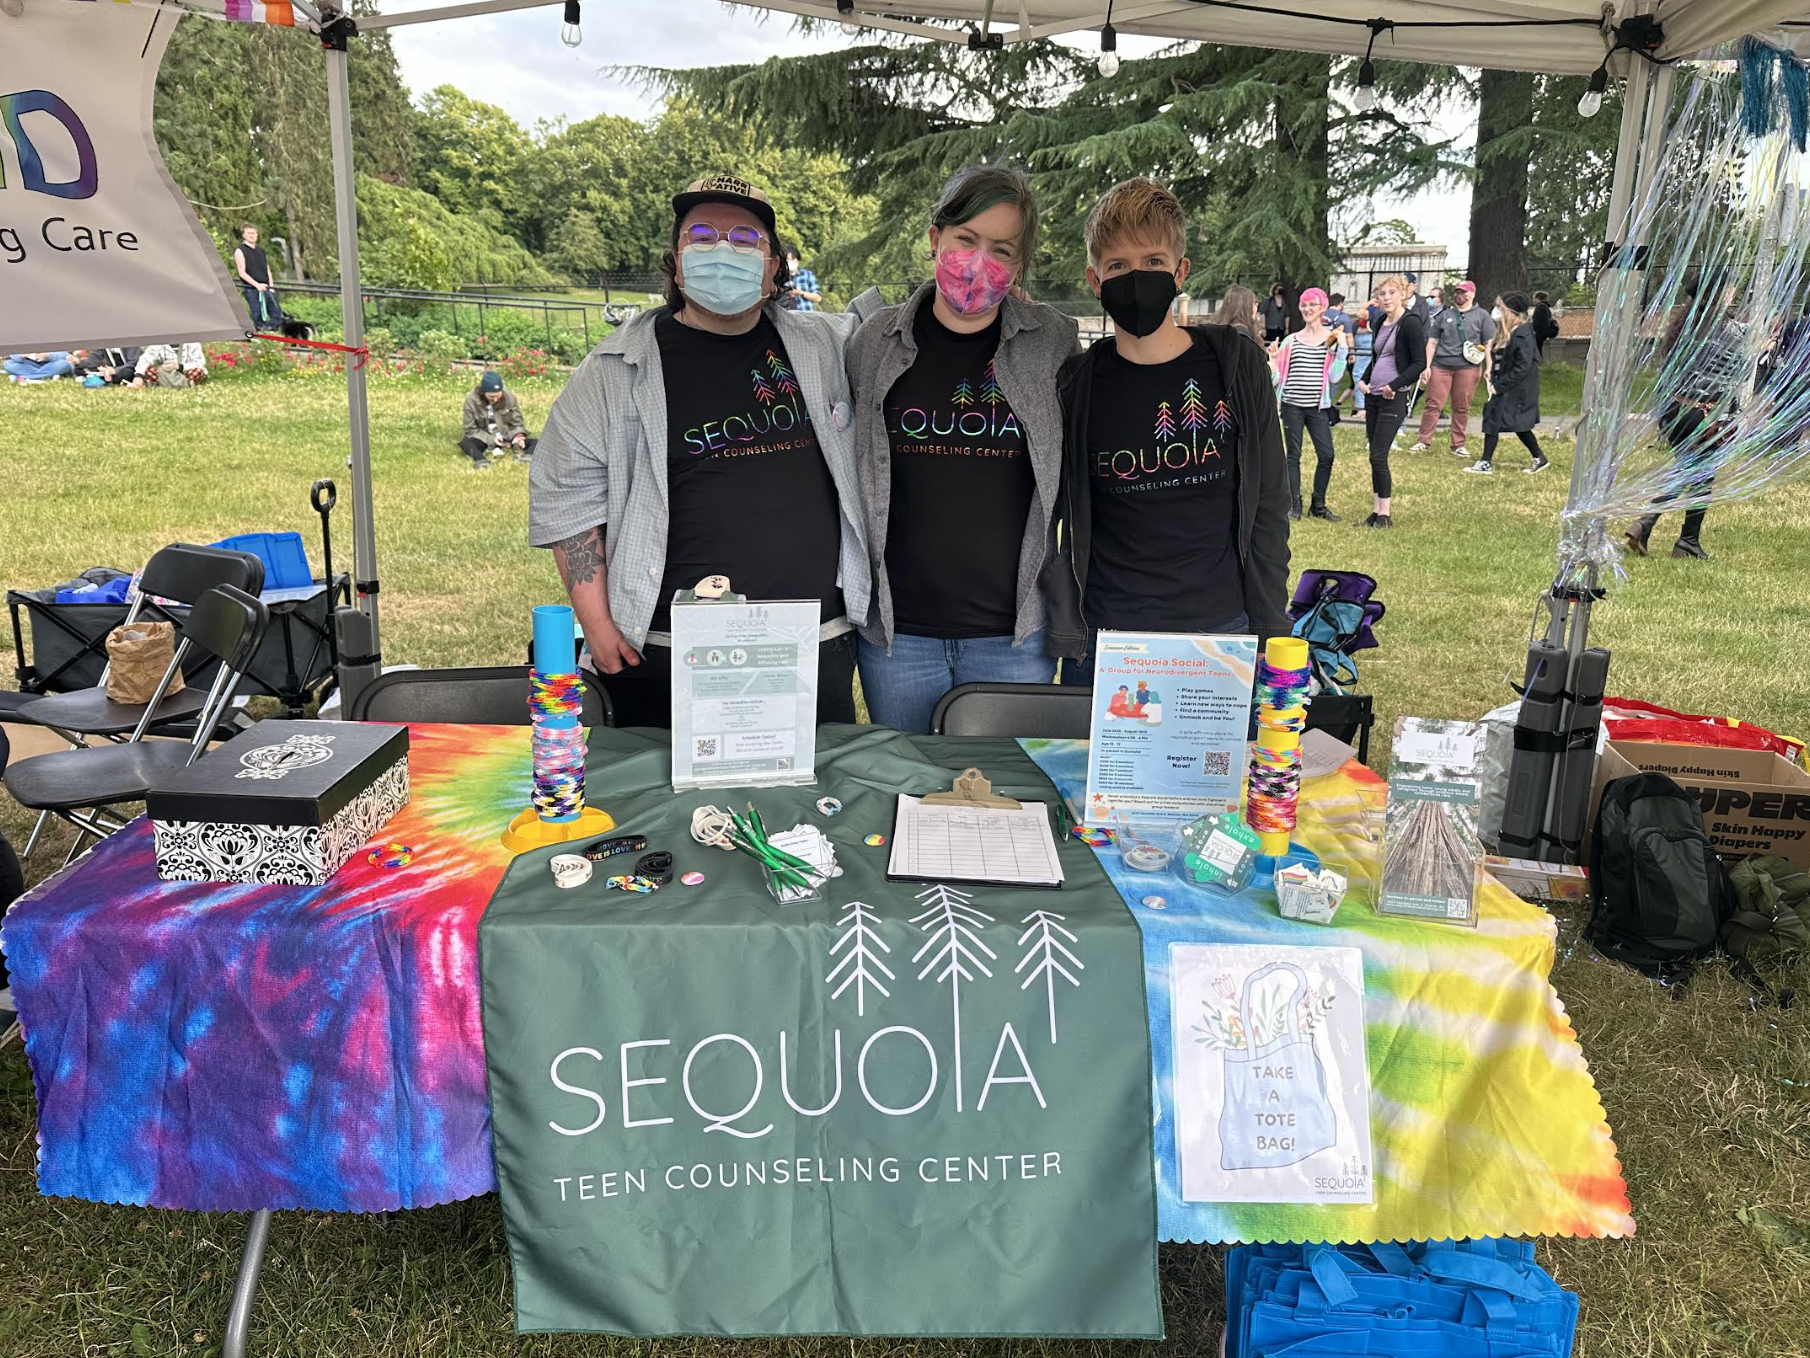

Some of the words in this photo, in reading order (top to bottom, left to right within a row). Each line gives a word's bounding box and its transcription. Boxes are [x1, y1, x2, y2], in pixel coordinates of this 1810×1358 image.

[715, 183, 747, 195] ATIVE
[716, 176, 748, 189] NARR
[41, 216, 139, 252] Care
[724, 442, 791, 458] COUNSELING
[896, 444, 971, 457] COUNSELING
[976, 447, 1023, 459] CENTER
[1110, 478, 1180, 494] COUNSELING
[1185, 469, 1227, 485] CENTER
[726, 619, 766, 629] SEQUOIA
[1123, 656, 1169, 667] Sequoia
[1171, 658, 1210, 668] Social:
[1146, 668, 1208, 677] Neurodivergent
[1166, 754, 1197, 762] Register
[1416, 748, 1454, 759] SEQUOIA
[1638, 763, 1679, 774] Diapers
[1680, 765, 1715, 777] Happy
[1716, 768, 1740, 778] Skin
[1224, 823, 1255, 843] exhale
[1711, 822, 1748, 835] Skin
[1751, 825, 1806, 840] Happy
[1709, 835, 1772, 850] Diapers
[611, 845, 631, 855] LOVE
[1195, 858, 1223, 878] inhale
[549, 1021, 1048, 1138] SEQUOIA
[1252, 1065, 1294, 1080] TAKE
[1268, 1088, 1280, 1103] A
[1254, 1113, 1296, 1127] TOTE
[1256, 1135, 1295, 1152] BAG!
[553, 1168, 646, 1201] TEEN
[665, 1157, 900, 1190] COUNSELING
[918, 1151, 1062, 1183] CENTER
[1314, 1177, 1365, 1190] SEQUOIA
